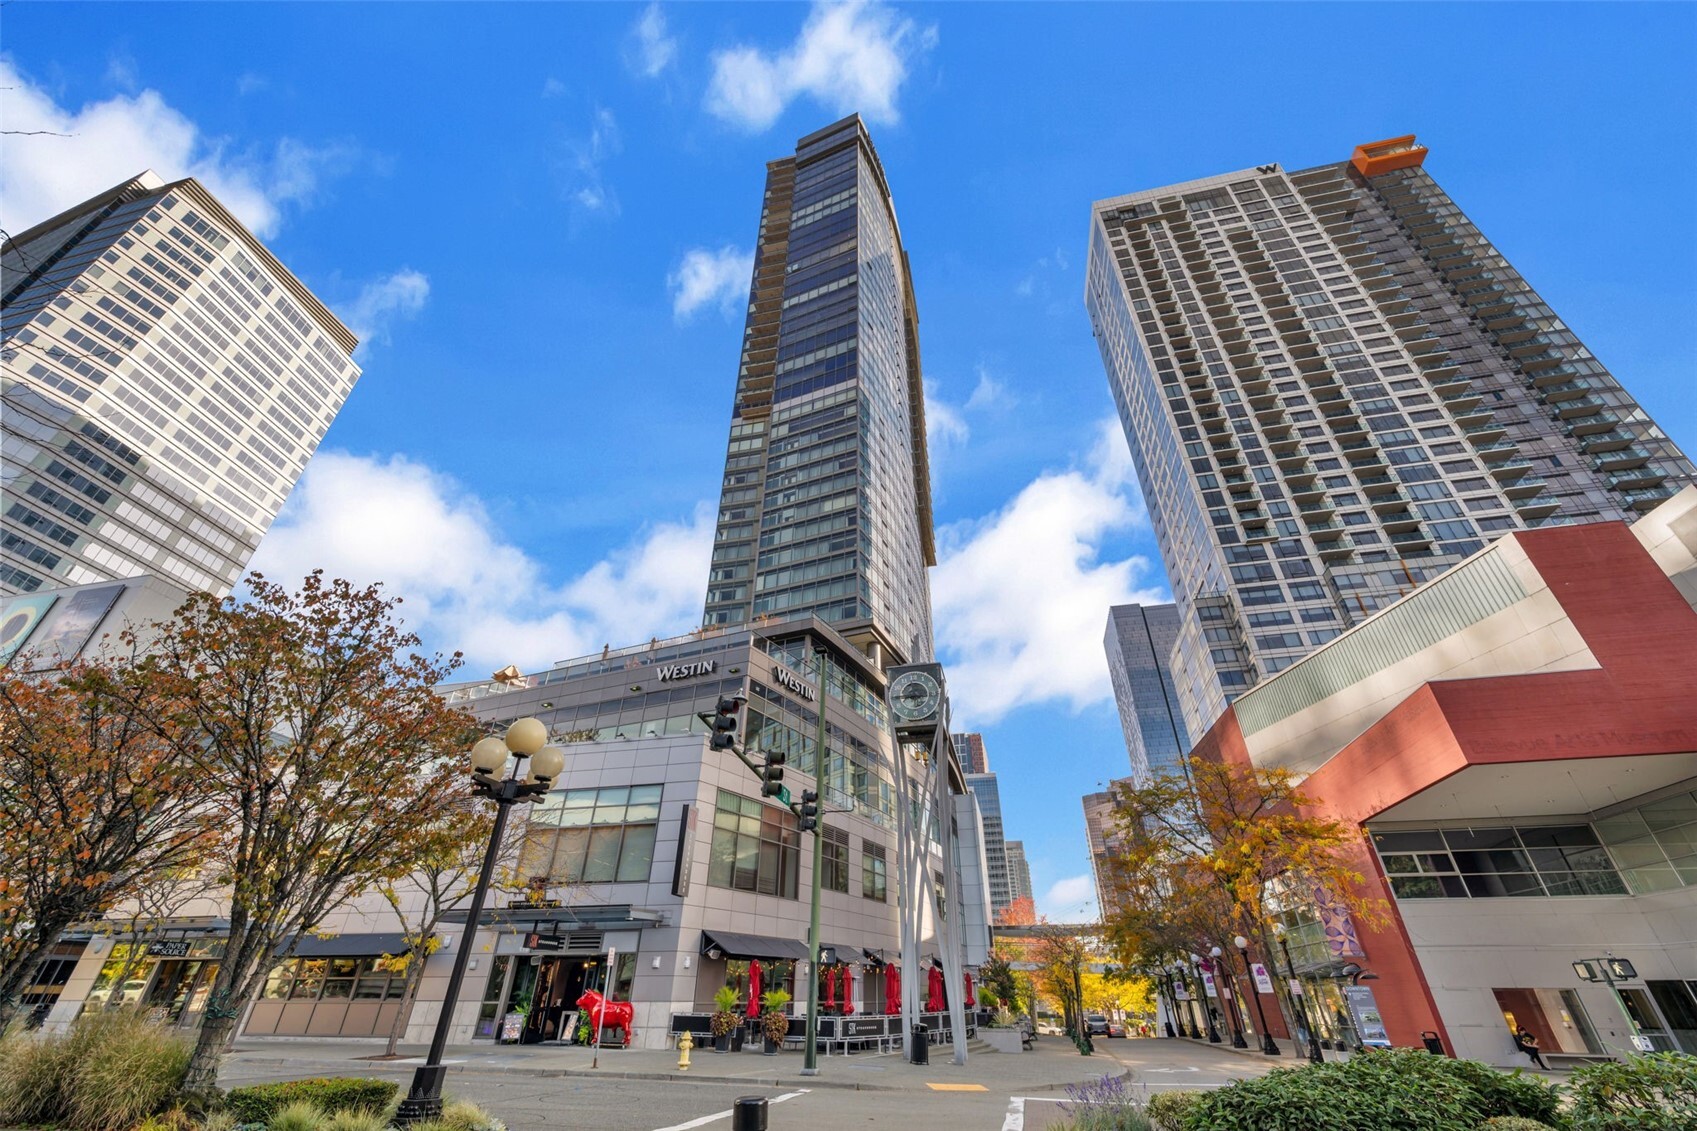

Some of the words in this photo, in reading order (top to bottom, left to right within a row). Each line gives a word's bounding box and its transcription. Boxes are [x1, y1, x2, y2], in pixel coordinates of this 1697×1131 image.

[1256, 163, 1277, 175] W
[656, 660, 714, 681] WESTIN
[775, 665, 816, 702] WESTIN
